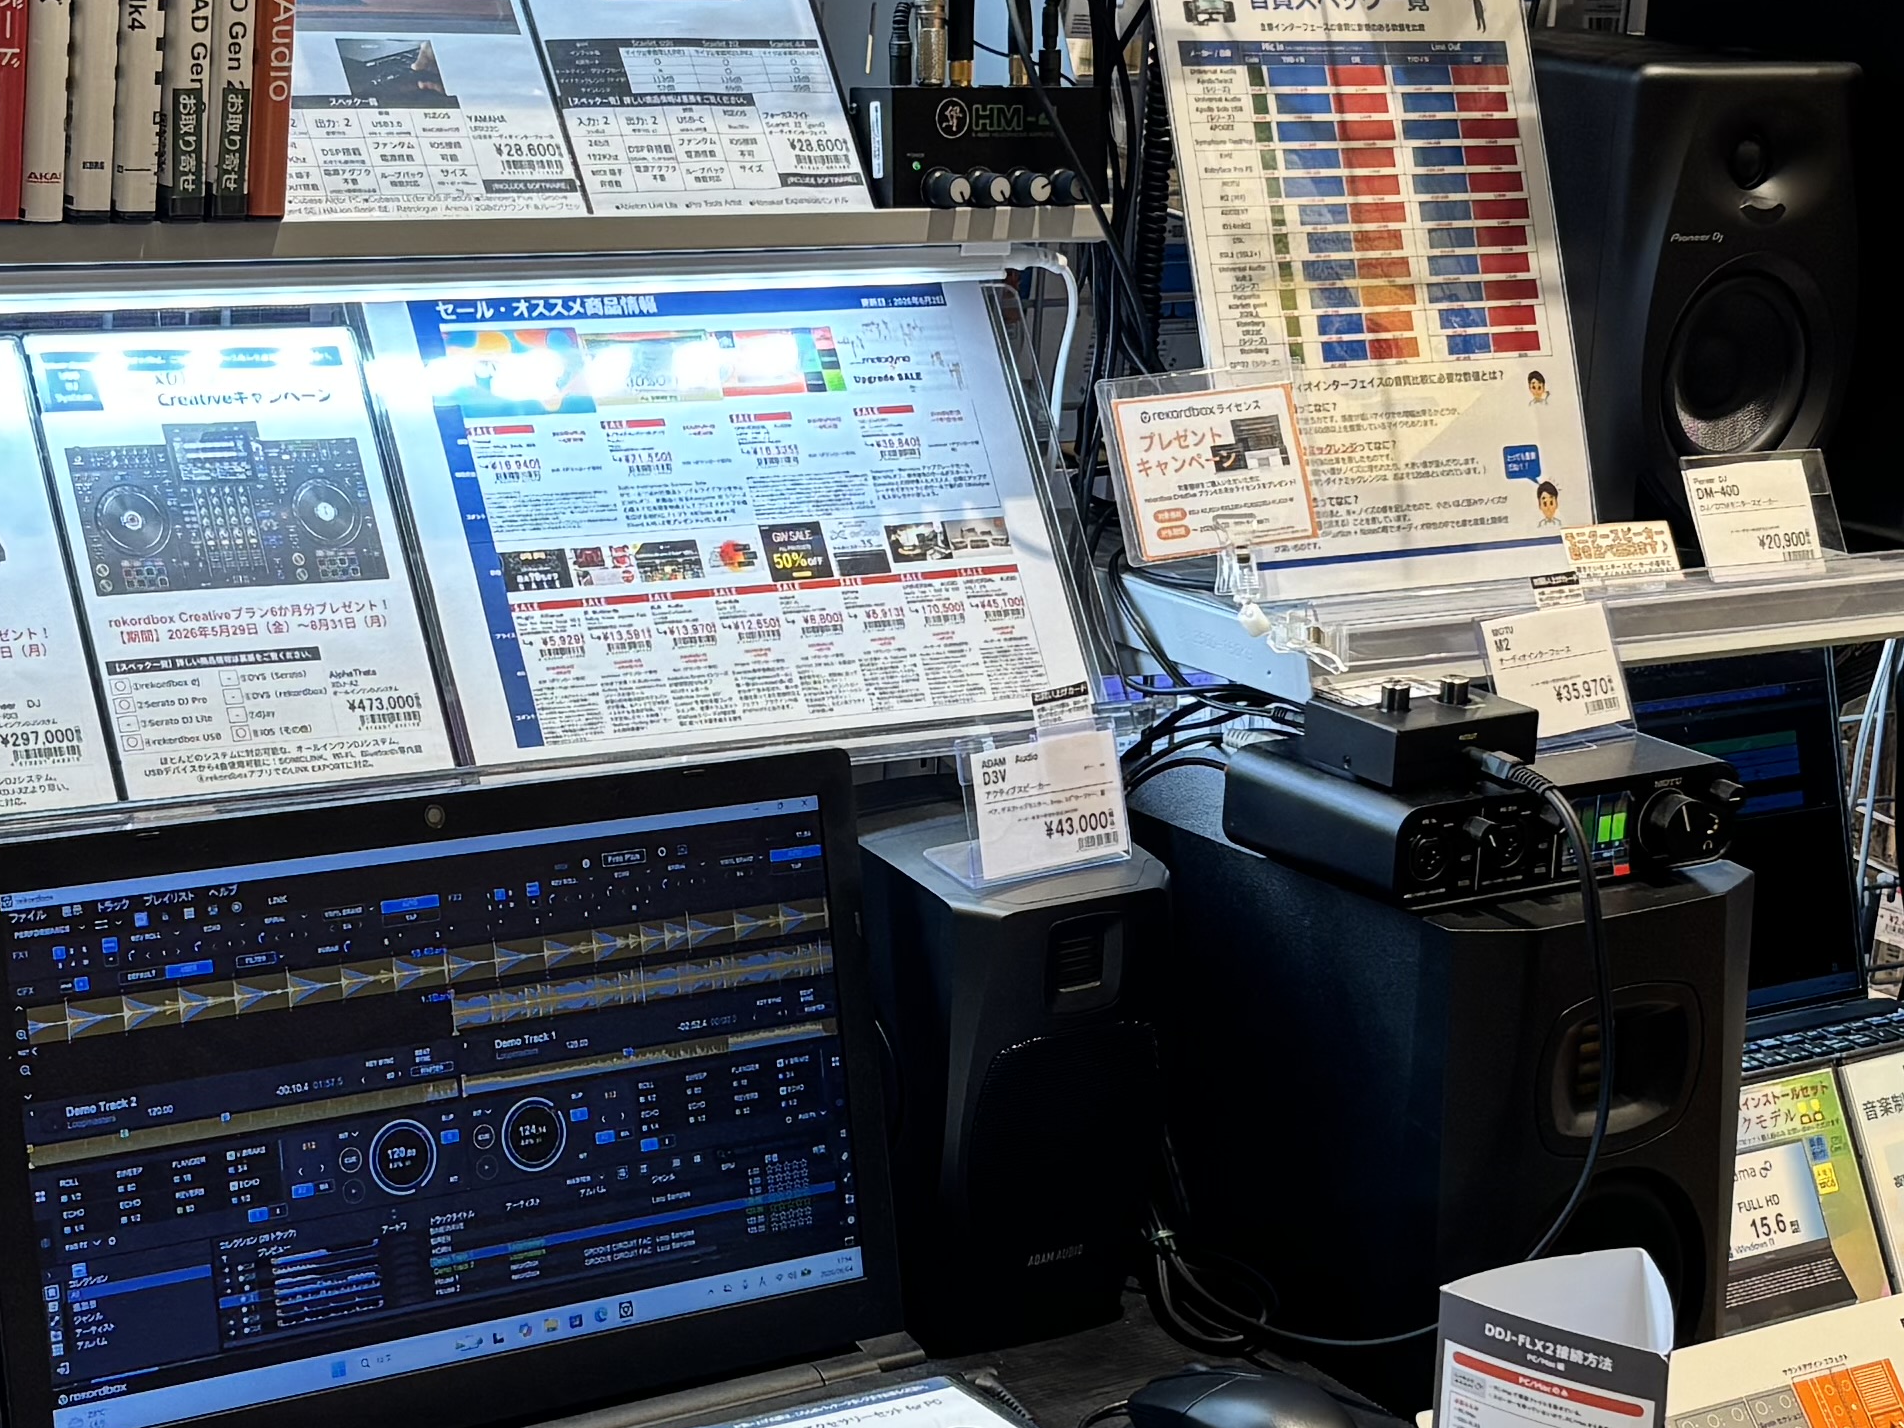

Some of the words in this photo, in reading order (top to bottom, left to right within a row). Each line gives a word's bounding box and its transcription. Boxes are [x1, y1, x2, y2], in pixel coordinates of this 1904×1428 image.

[493, 143, 557, 158] ¥28,600
[787, 138, 847, 154] ¥28,600
[435, 296, 657, 319] セール・オススメ商品情報
[1139, 429, 1223, 450] プレゼント
[1137, 452, 1236, 477] キャンペーン
[1495, 638, 1510, 653] M2
[1552, 680, 1610, 702] ¥35,970
[347, 695, 419, 714] ¥473,000
[0, 728, 76, 748] ¥297,000
[982, 768, 1007, 785] D3V
[1045, 811, 1108, 838] ¥43,000
[1484, 1322, 1612, 1373] DDJ-FLX2接続方法
[69, 1381, 127, 1402] rekordbox
